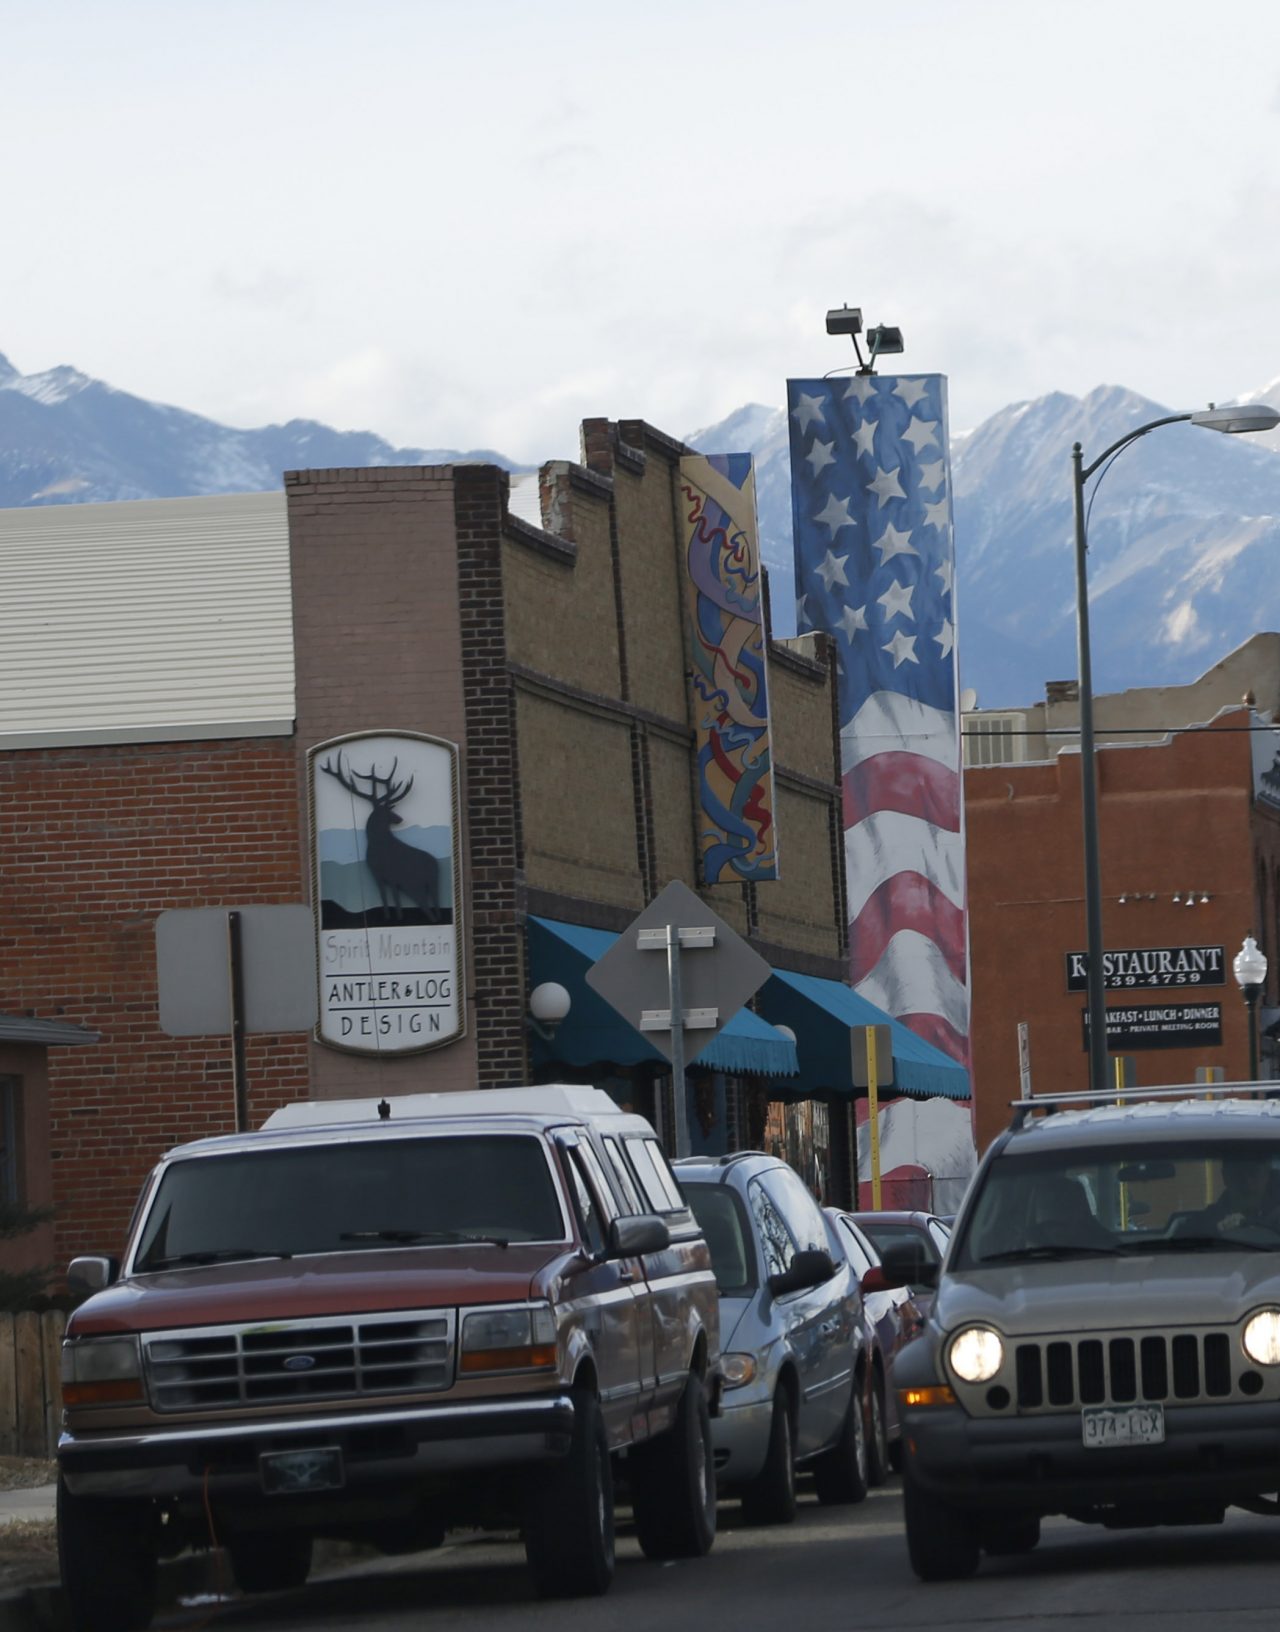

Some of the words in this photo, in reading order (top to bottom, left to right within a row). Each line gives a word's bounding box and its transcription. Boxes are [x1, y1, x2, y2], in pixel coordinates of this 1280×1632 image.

[325, 935, 371, 968] Spirit
[378, 932, 450, 960] Mountain
[1071, 948, 1222, 977] RSTAURANT
[328, 981, 402, 1003] ANTLER
[404, 984, 414, 998] &
[416, 978, 451, 1000] LOG
[341, 1013, 440, 1036] DESIGN
[1143, 1009, 1177, 1022] LUNCH
[1183, 1007, 1220, 1020] DINNER
[1129, 1024, 1159, 1033] PRIVATE
[1194, 1021, 1219, 1029] ROOM
